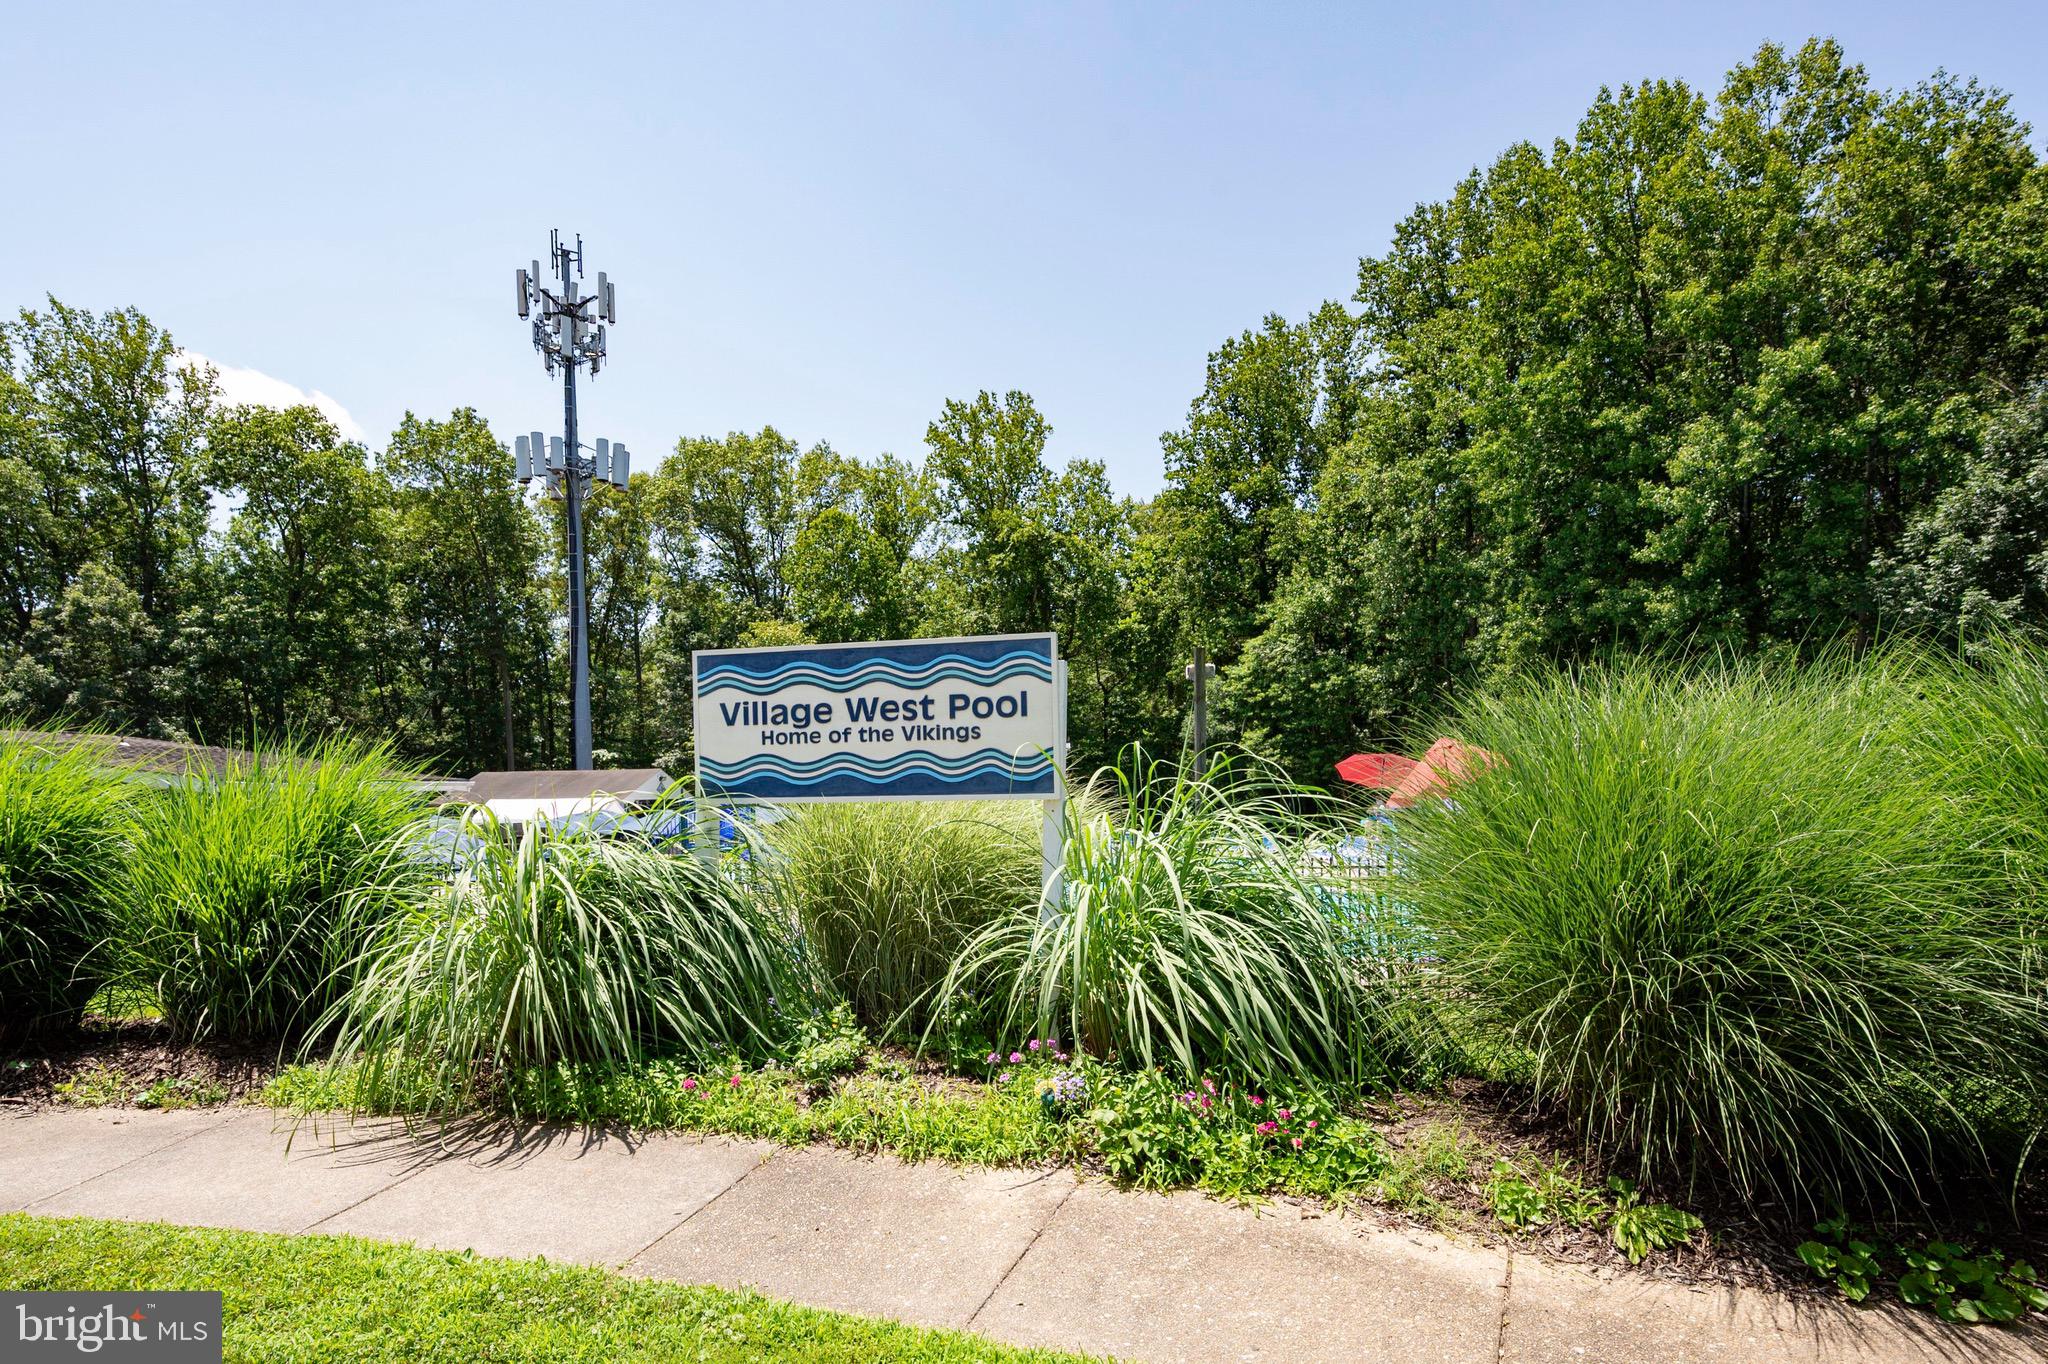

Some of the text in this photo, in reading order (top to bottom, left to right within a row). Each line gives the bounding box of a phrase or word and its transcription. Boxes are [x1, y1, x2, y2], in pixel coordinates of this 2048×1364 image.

[720, 690, 1029, 729] Village West Pool
[761, 724, 982, 746] Home of the Vikings
